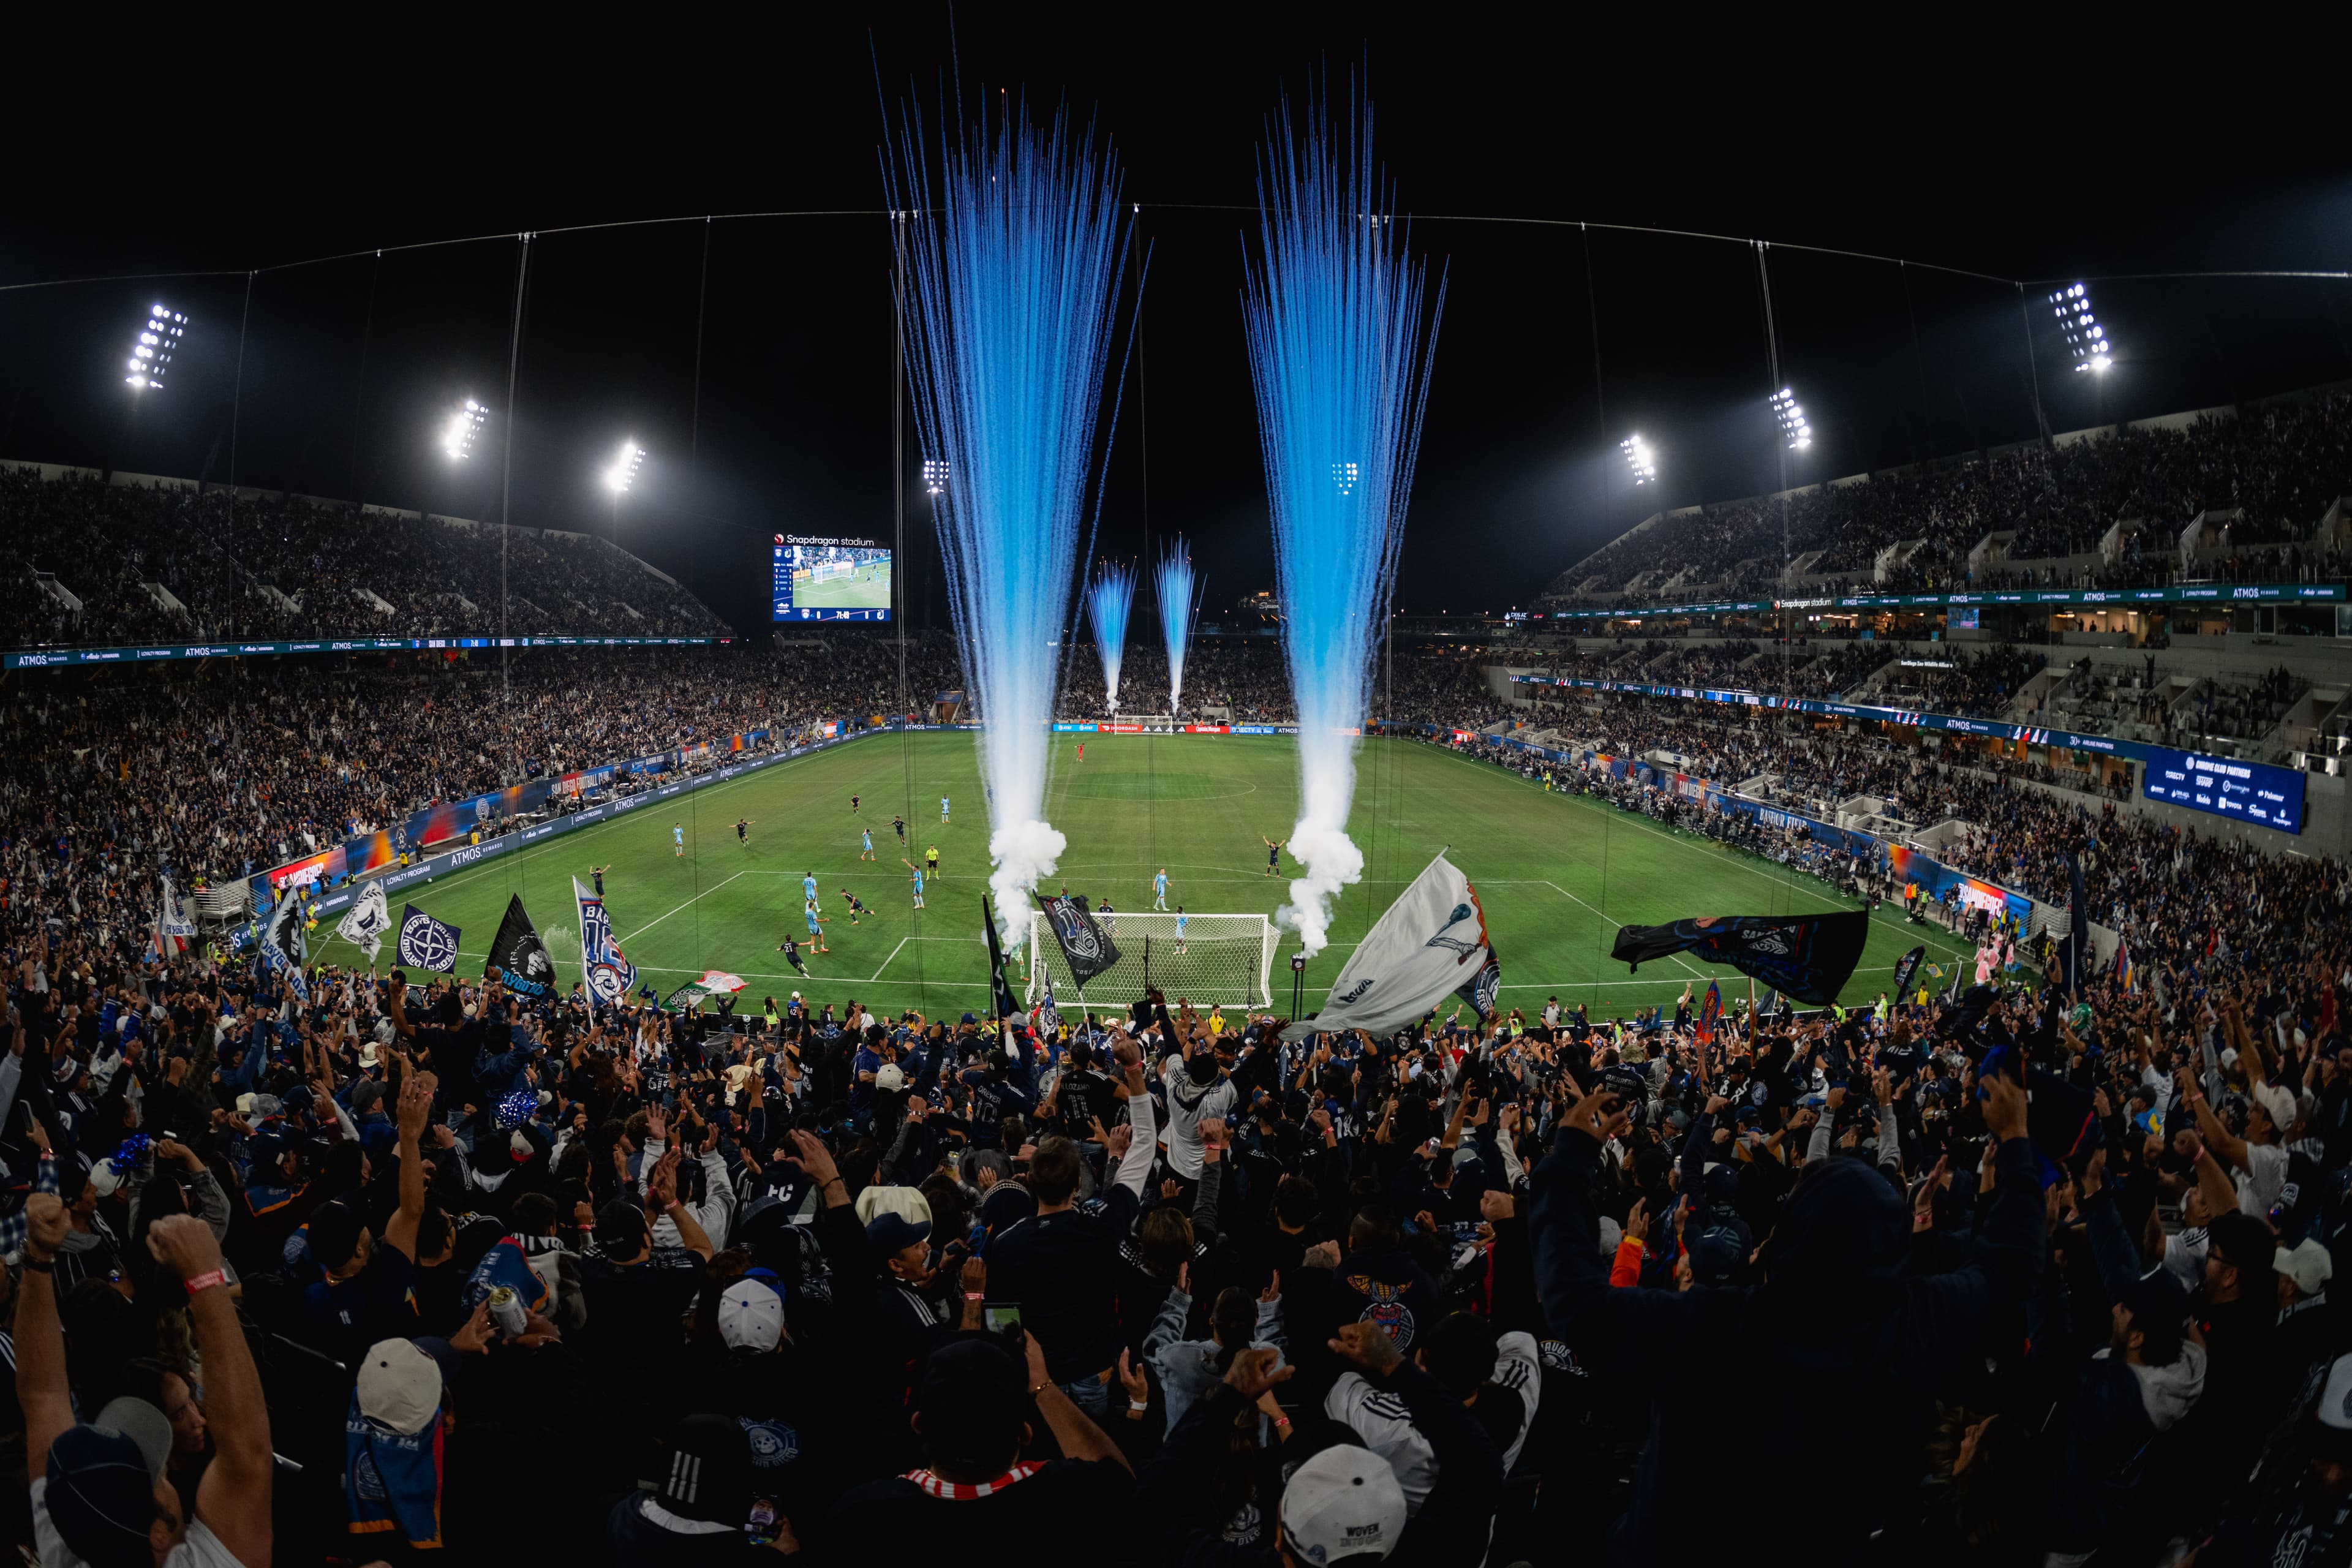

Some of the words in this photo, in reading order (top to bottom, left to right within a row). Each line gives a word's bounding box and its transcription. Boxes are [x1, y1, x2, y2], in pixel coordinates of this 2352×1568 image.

[786, 535, 839, 547] Snapdragon
[840, 537, 874, 546] stadium
[2084, 593, 2105, 601] ATMOS
[2233, 588, 2259, 598] ATMOS
[1781, 599, 1810, 609] Snapdragon
[816, 611, 821, 619] 0
[836, 611, 850, 619] 71:49
[865, 611, 869, 619] 0
[185, 647, 210, 657] ATMOS
[19, 655, 47, 666] ATMOS
[1947, 719, 1970, 730] ATMOS
[2070, 736, 2081, 746] 30+
[2096, 741, 2114, 750] PARTNERS
[720, 768, 733, 778] ATMOS
[2195, 760, 2214, 771] CHROME
[2214, 764, 2226, 774] CLUB
[2226, 766, 2251, 779] PARTNERS
[2165, 771, 2185, 782] DIRECTV
[551, 783, 562, 794] SAN
[562, 780, 576, 793] DIEGO
[576, 774, 598, 790] FOOTBALL
[1679, 781, 1689, 795] SAN
[1689, 783, 1702, 799] DIEGO
[2264, 791, 2285, 802] Palomar
[615, 798, 634, 812] ATMOS
[2226, 801, 2242, 810] TOYOTA
[575, 812, 589, 822] LOYALTY
[589, 809, 603, 819] PROGRAM
[451, 847, 481, 867] ATMOS
[483, 842, 503, 853] REWARDS
[386, 873, 407, 886] LOYALTY
[407, 865, 431, 880] PROGRAM
[326, 894, 349, 907] HAWAIIAN
[405, 917, 430, 934] BOYS
[434, 923, 454, 950] DAYGO
[402, 938, 423, 968] DAYGO
[428, 954, 453, 971] BOYS
[1605, 1073, 1638, 1087] GUERRERO
[977, 1085, 1001, 1105] DREYER
[974, 1096, 998, 1125] 10
[1068, 1095, 1090, 1120] 11
[774, 1448, 798, 1466] DIEGO
[1346, 1523, 1379, 1537] WOVEN
[1340, 1537, 1366, 1547] INTO
